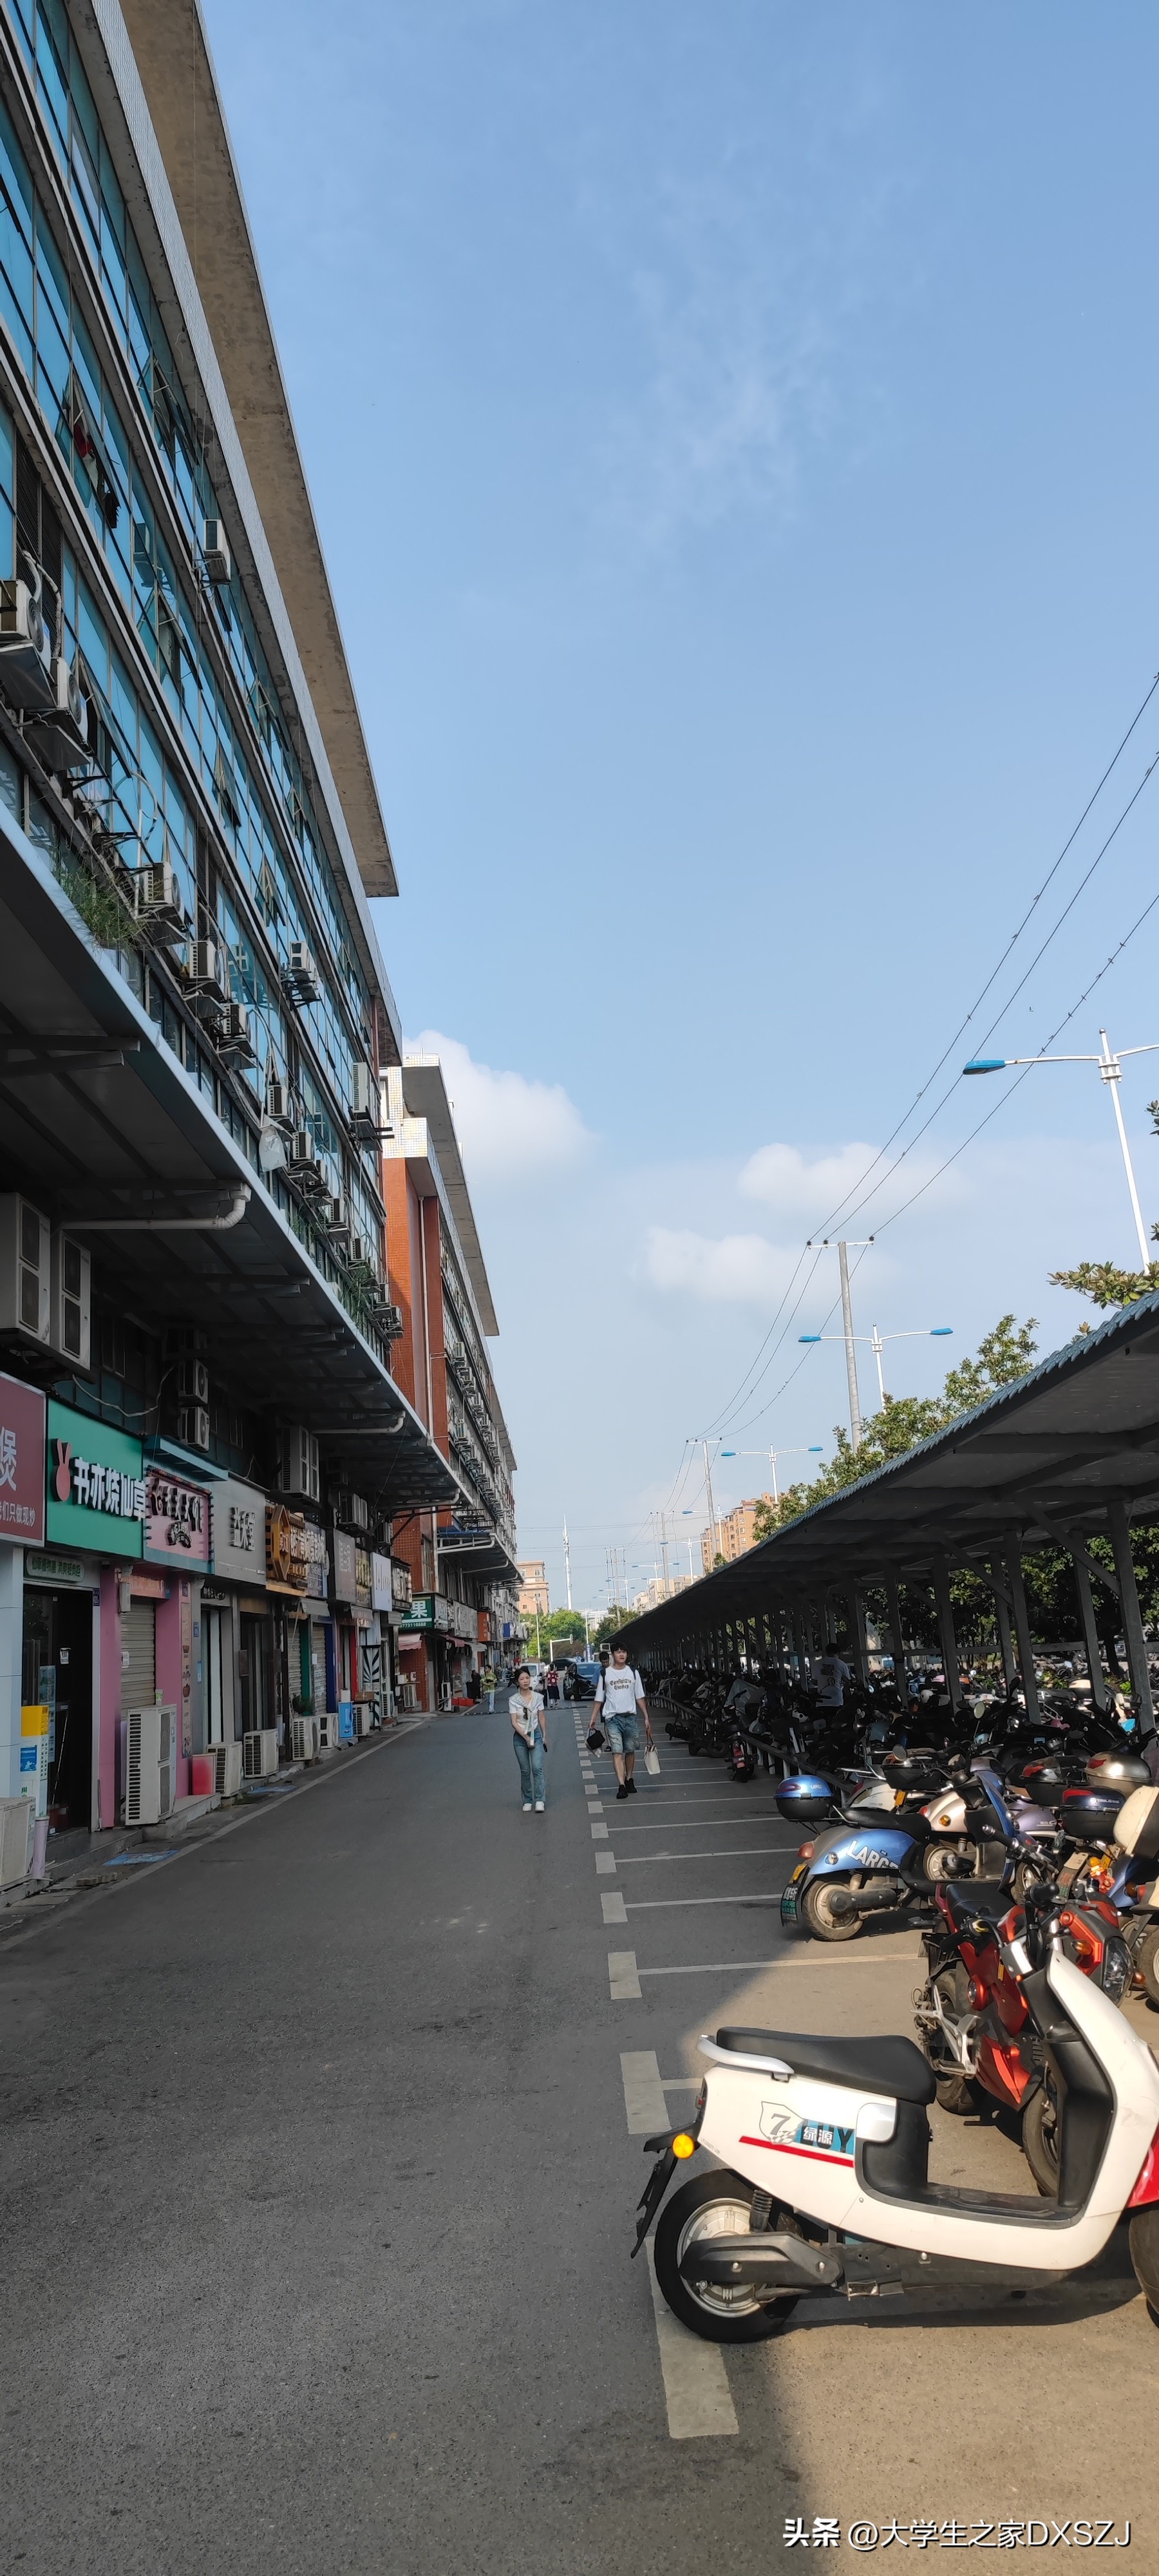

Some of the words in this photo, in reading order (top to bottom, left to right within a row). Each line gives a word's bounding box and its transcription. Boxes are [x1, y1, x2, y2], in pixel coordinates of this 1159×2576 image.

[0, 1425, 17, 1492] 煲
[73, 1456, 146, 1522] 书亦烧仙草
[0, 1500, 36, 1527] 们只做现炒
[402, 1600, 428, 1618] 果
[770, 2113, 791, 2136] 7
[803, 2126, 834, 2146] 绿源
